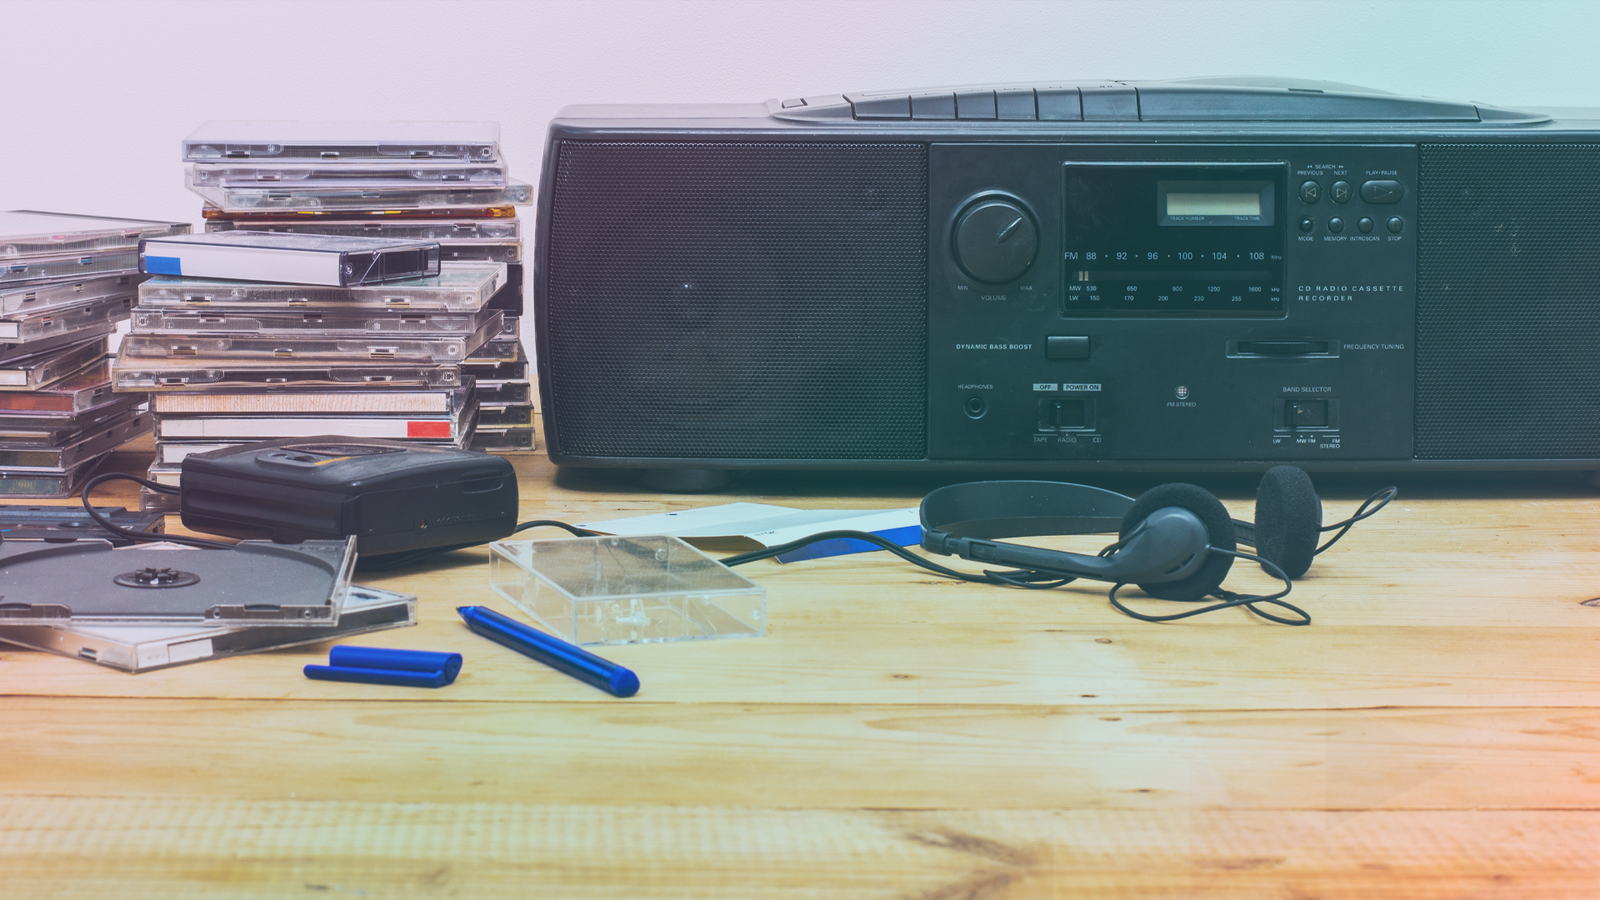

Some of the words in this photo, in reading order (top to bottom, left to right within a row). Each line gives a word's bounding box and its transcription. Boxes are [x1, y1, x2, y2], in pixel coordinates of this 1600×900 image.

[1064, 252, 1078, 260] FM
[1085, 252, 1097, 260] 88
[1116, 252, 1127, 260] 92
[1147, 252, 1158, 260] 96
[1178, 252, 1193, 260] 100
[1212, 252, 1227, 260] 104
[1249, 252, 1265, 260] 108
